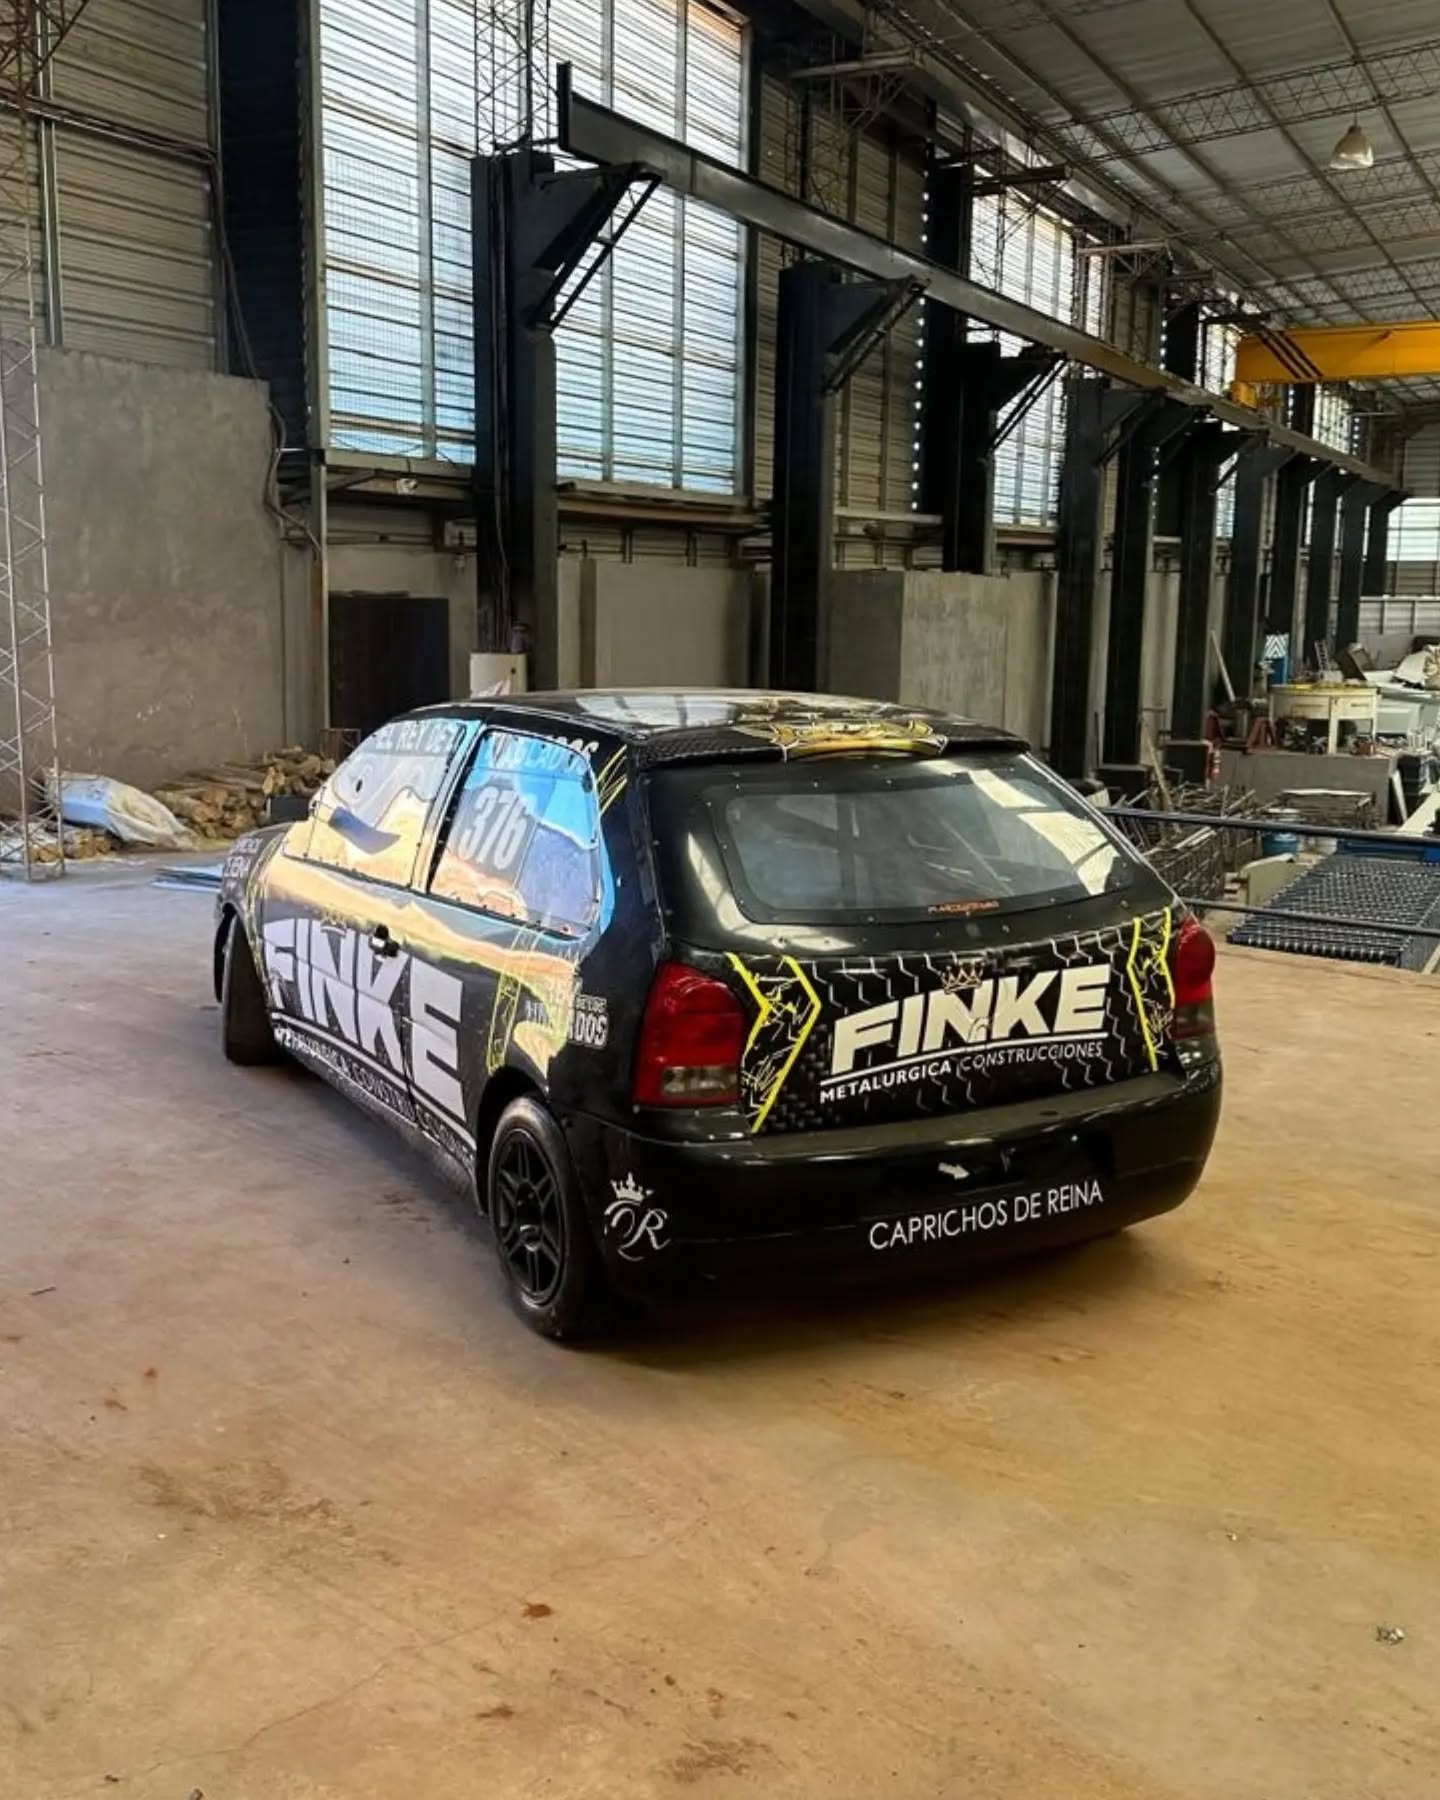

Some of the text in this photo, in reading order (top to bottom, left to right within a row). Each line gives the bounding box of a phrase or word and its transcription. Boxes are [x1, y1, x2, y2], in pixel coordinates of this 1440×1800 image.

[264, 917, 467, 1122] FINKE
[831, 963, 1111, 1076] FINKE
[820, 1041, 1103, 1104] METALURGICA CONSTRUCCIONES
[869, 1179, 1104, 1250] CAPRICHOS DE REINA
